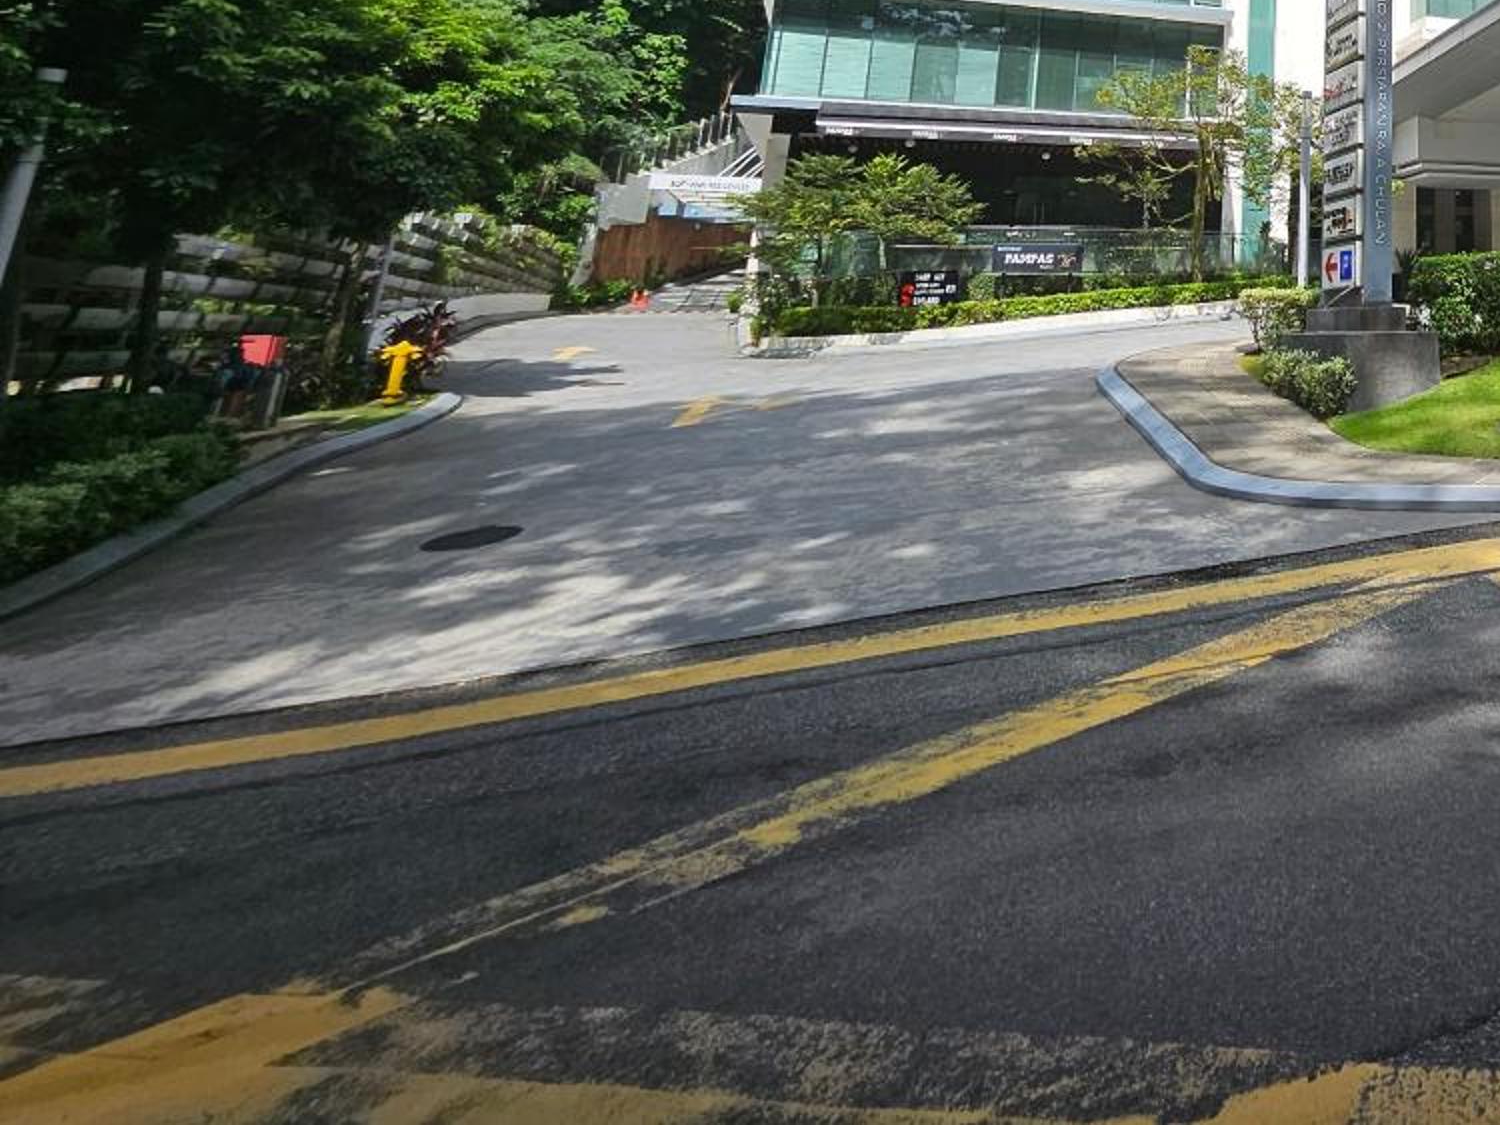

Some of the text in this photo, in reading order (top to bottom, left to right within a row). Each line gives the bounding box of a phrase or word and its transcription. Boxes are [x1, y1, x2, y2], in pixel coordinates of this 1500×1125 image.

[1377, 38, 1387, 125] PERSIARAN
[1376, 174, 1387, 245] CHULAN
[1004, 252, 1055, 264] PAMPAS
